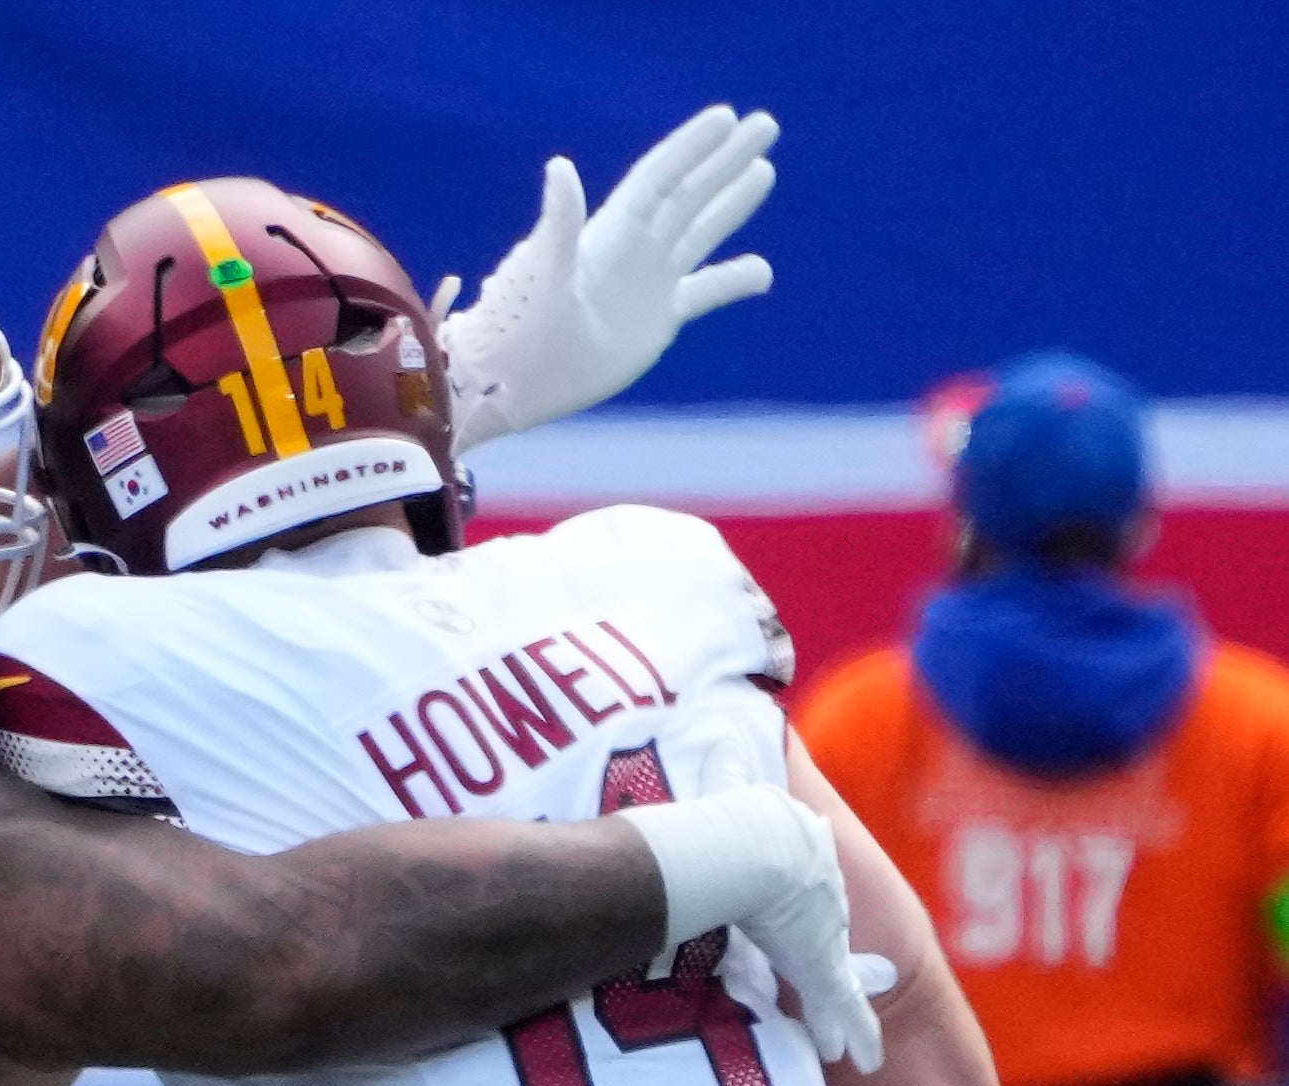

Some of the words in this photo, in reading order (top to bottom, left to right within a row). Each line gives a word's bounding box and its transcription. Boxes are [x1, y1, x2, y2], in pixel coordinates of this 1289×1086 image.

[218, 346, 348, 456] 14
[208, 459, 407, 530] WASHINGTON
[357, 620, 678, 820] HOWELL
[950, 818, 1136, 968] 917
